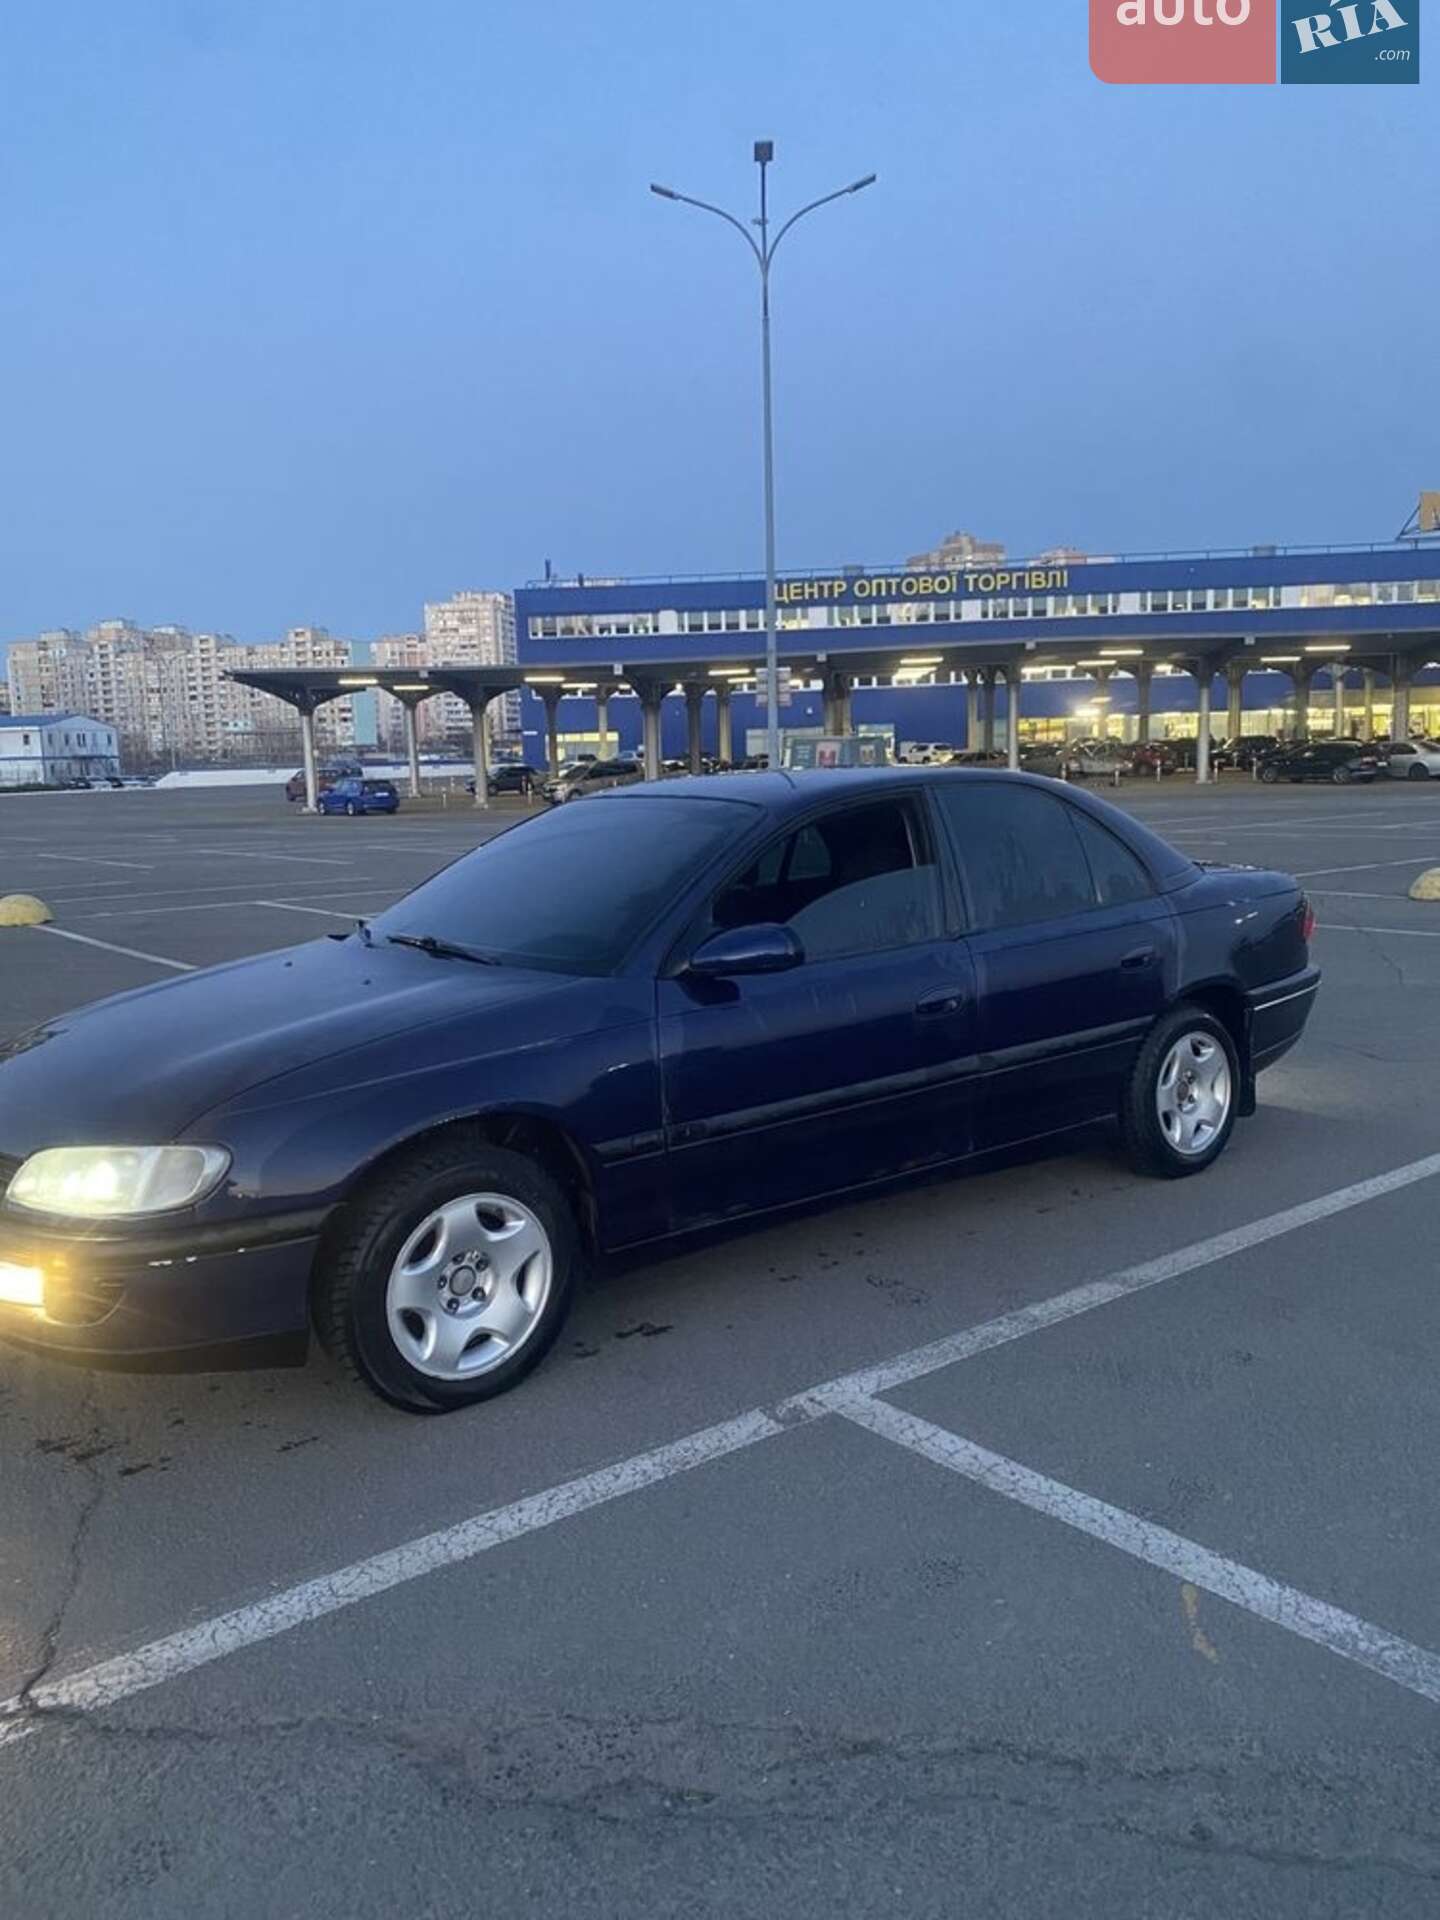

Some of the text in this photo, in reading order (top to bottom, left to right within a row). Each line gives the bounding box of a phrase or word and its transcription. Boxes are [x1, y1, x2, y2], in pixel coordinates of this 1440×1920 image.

[774, 569, 1069, 604] ЦЕНТР ОПТОВОЇ ТОРГІВЛІ
